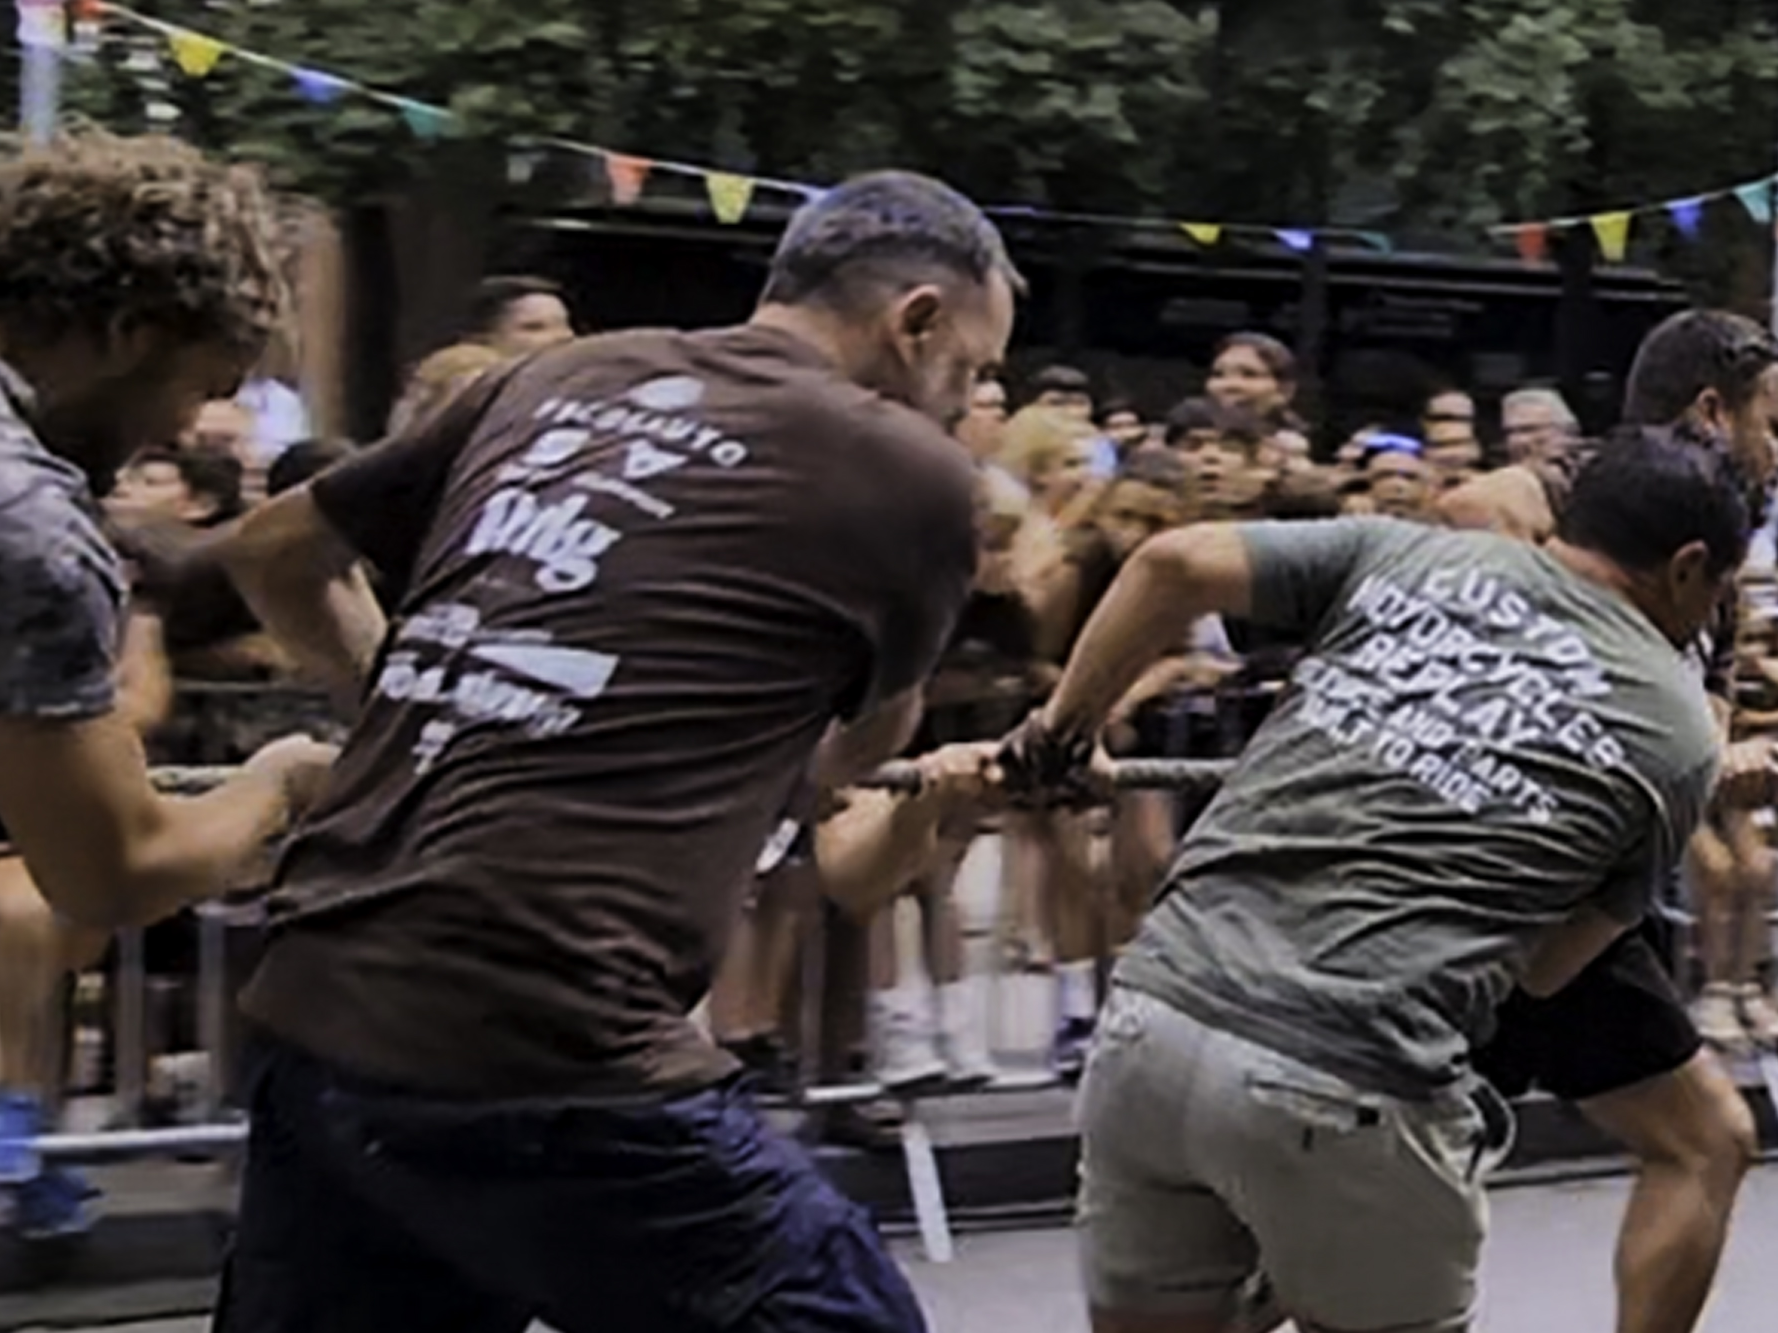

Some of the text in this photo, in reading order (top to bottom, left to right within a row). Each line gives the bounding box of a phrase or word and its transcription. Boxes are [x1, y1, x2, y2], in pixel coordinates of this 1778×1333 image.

[1424, 568, 1612, 696] CUSTOM
[1351, 633, 1542, 750] REPLAY
[1386, 702, 1456, 749] AND
[1375, 730, 1416, 768] TO
[1409, 752, 1494, 814] RIDE
